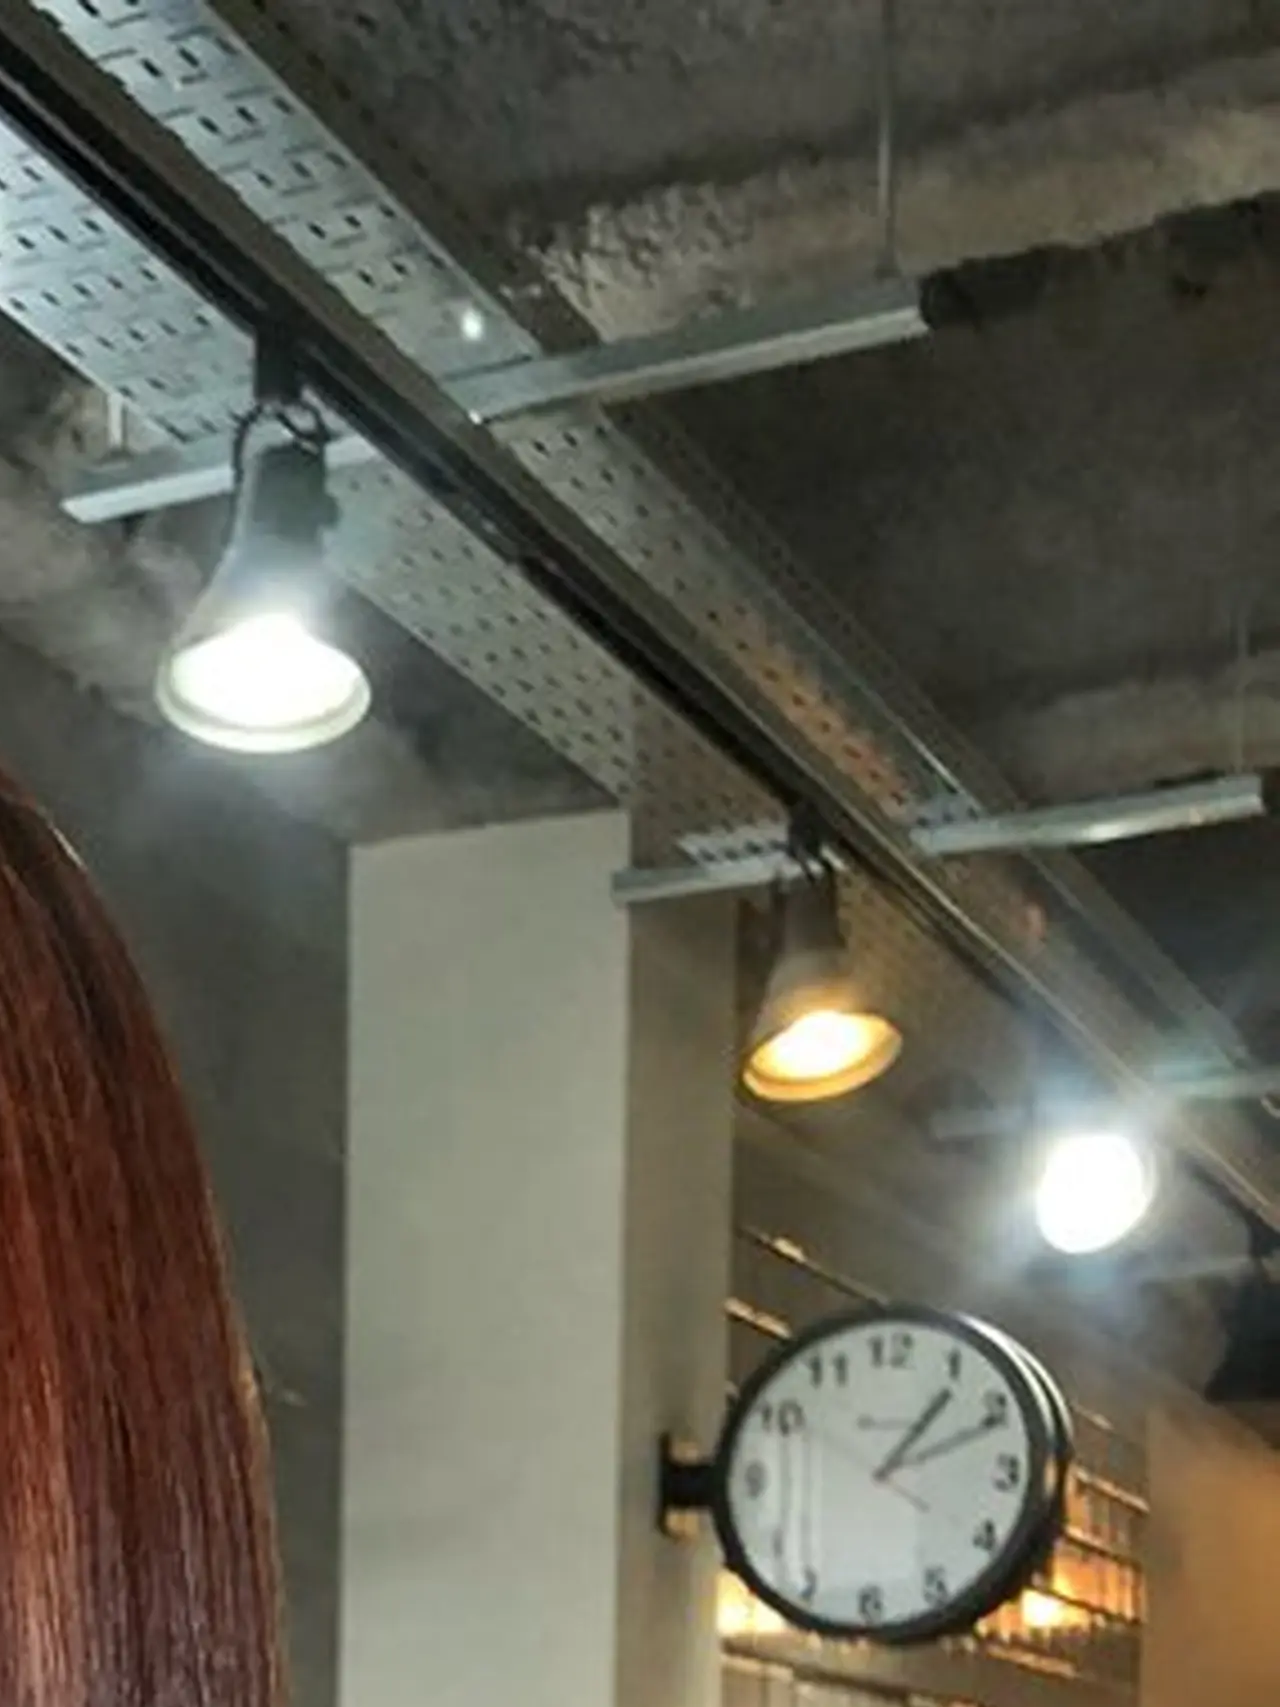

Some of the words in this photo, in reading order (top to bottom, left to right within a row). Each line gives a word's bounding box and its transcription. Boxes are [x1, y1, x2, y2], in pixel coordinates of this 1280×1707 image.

[868, 1333, 913, 1368] 12
[947, 1346, 962, 1380] 1
[808, 1353, 848, 1388] 11
[759, 1401, 804, 1437] 10
[993, 1452, 1020, 1492] 3
